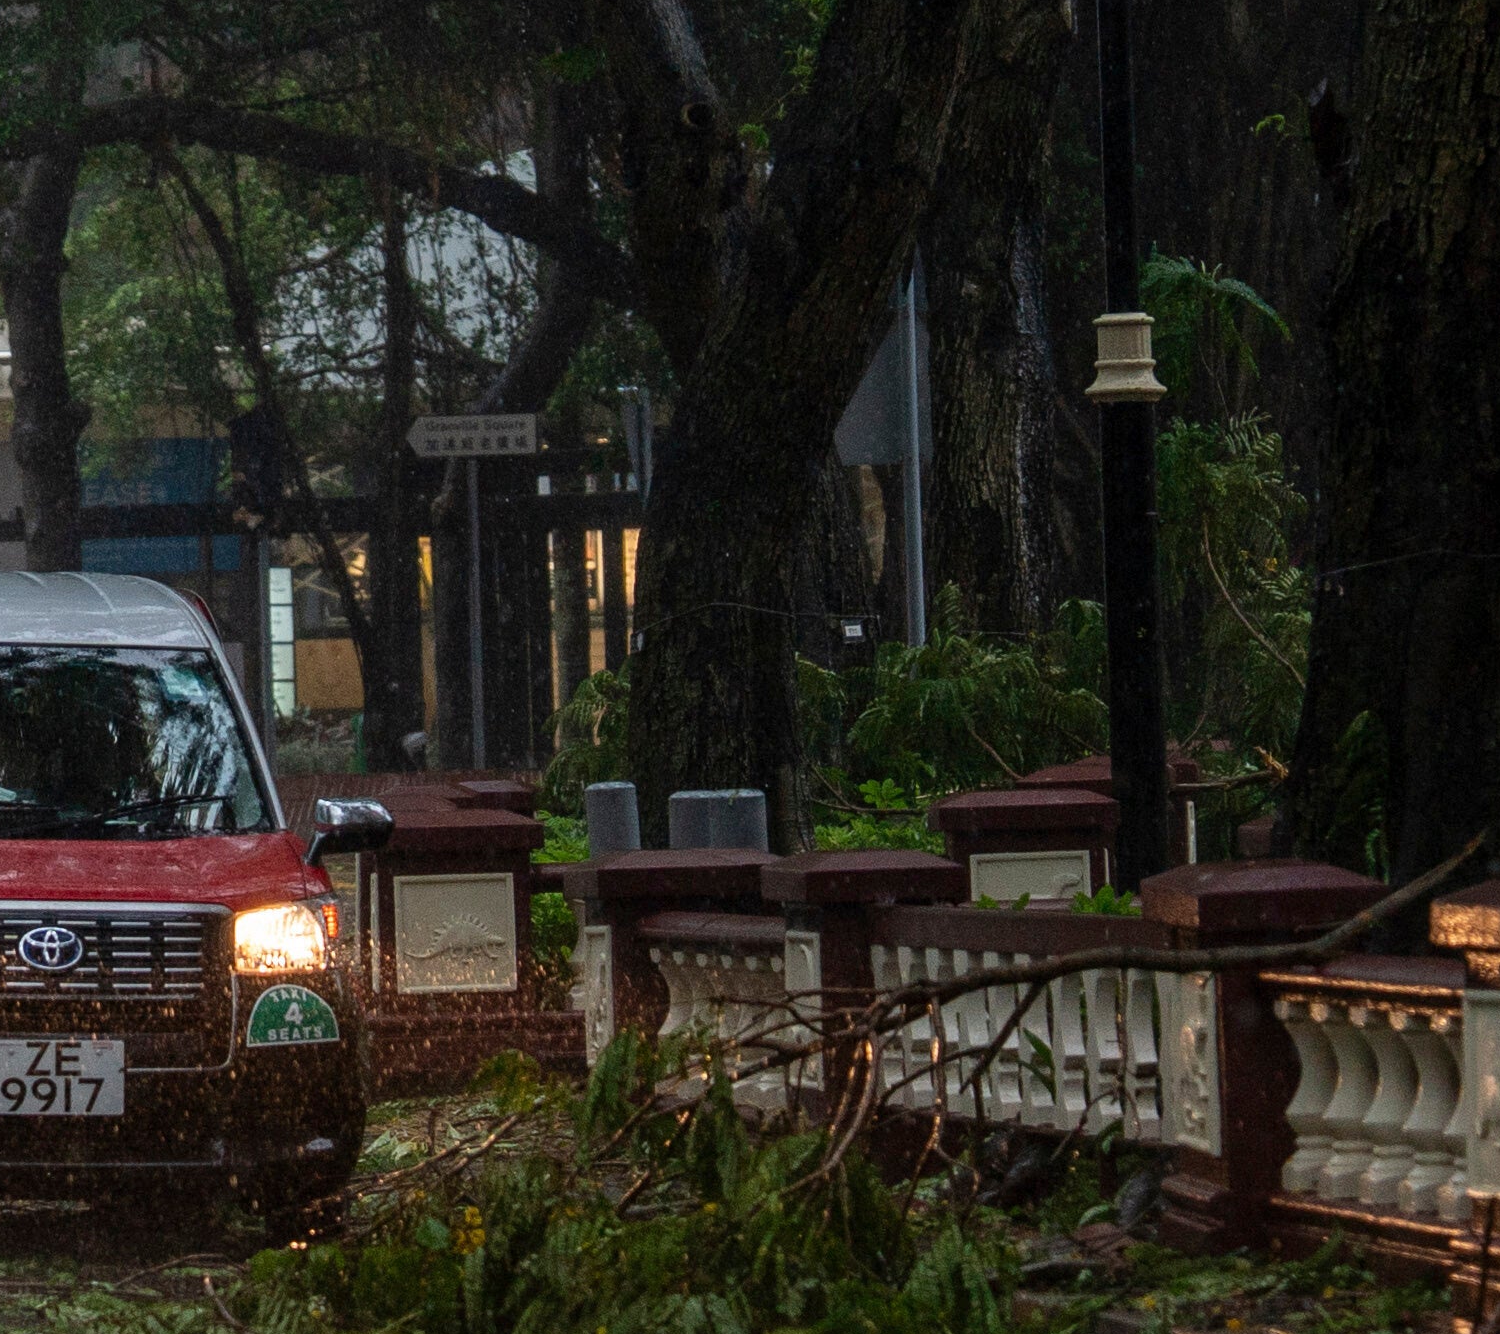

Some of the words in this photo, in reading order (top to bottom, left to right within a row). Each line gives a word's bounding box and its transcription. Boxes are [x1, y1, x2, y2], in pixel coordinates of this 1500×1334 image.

[268, 987, 308, 1003] TAXI
[285, 1001, 302, 1025] 4
[267, 1024, 325, 1041] SEATS
[25, 1041, 83, 1077] ZE
[0, 1077, 105, 1113] 9917
